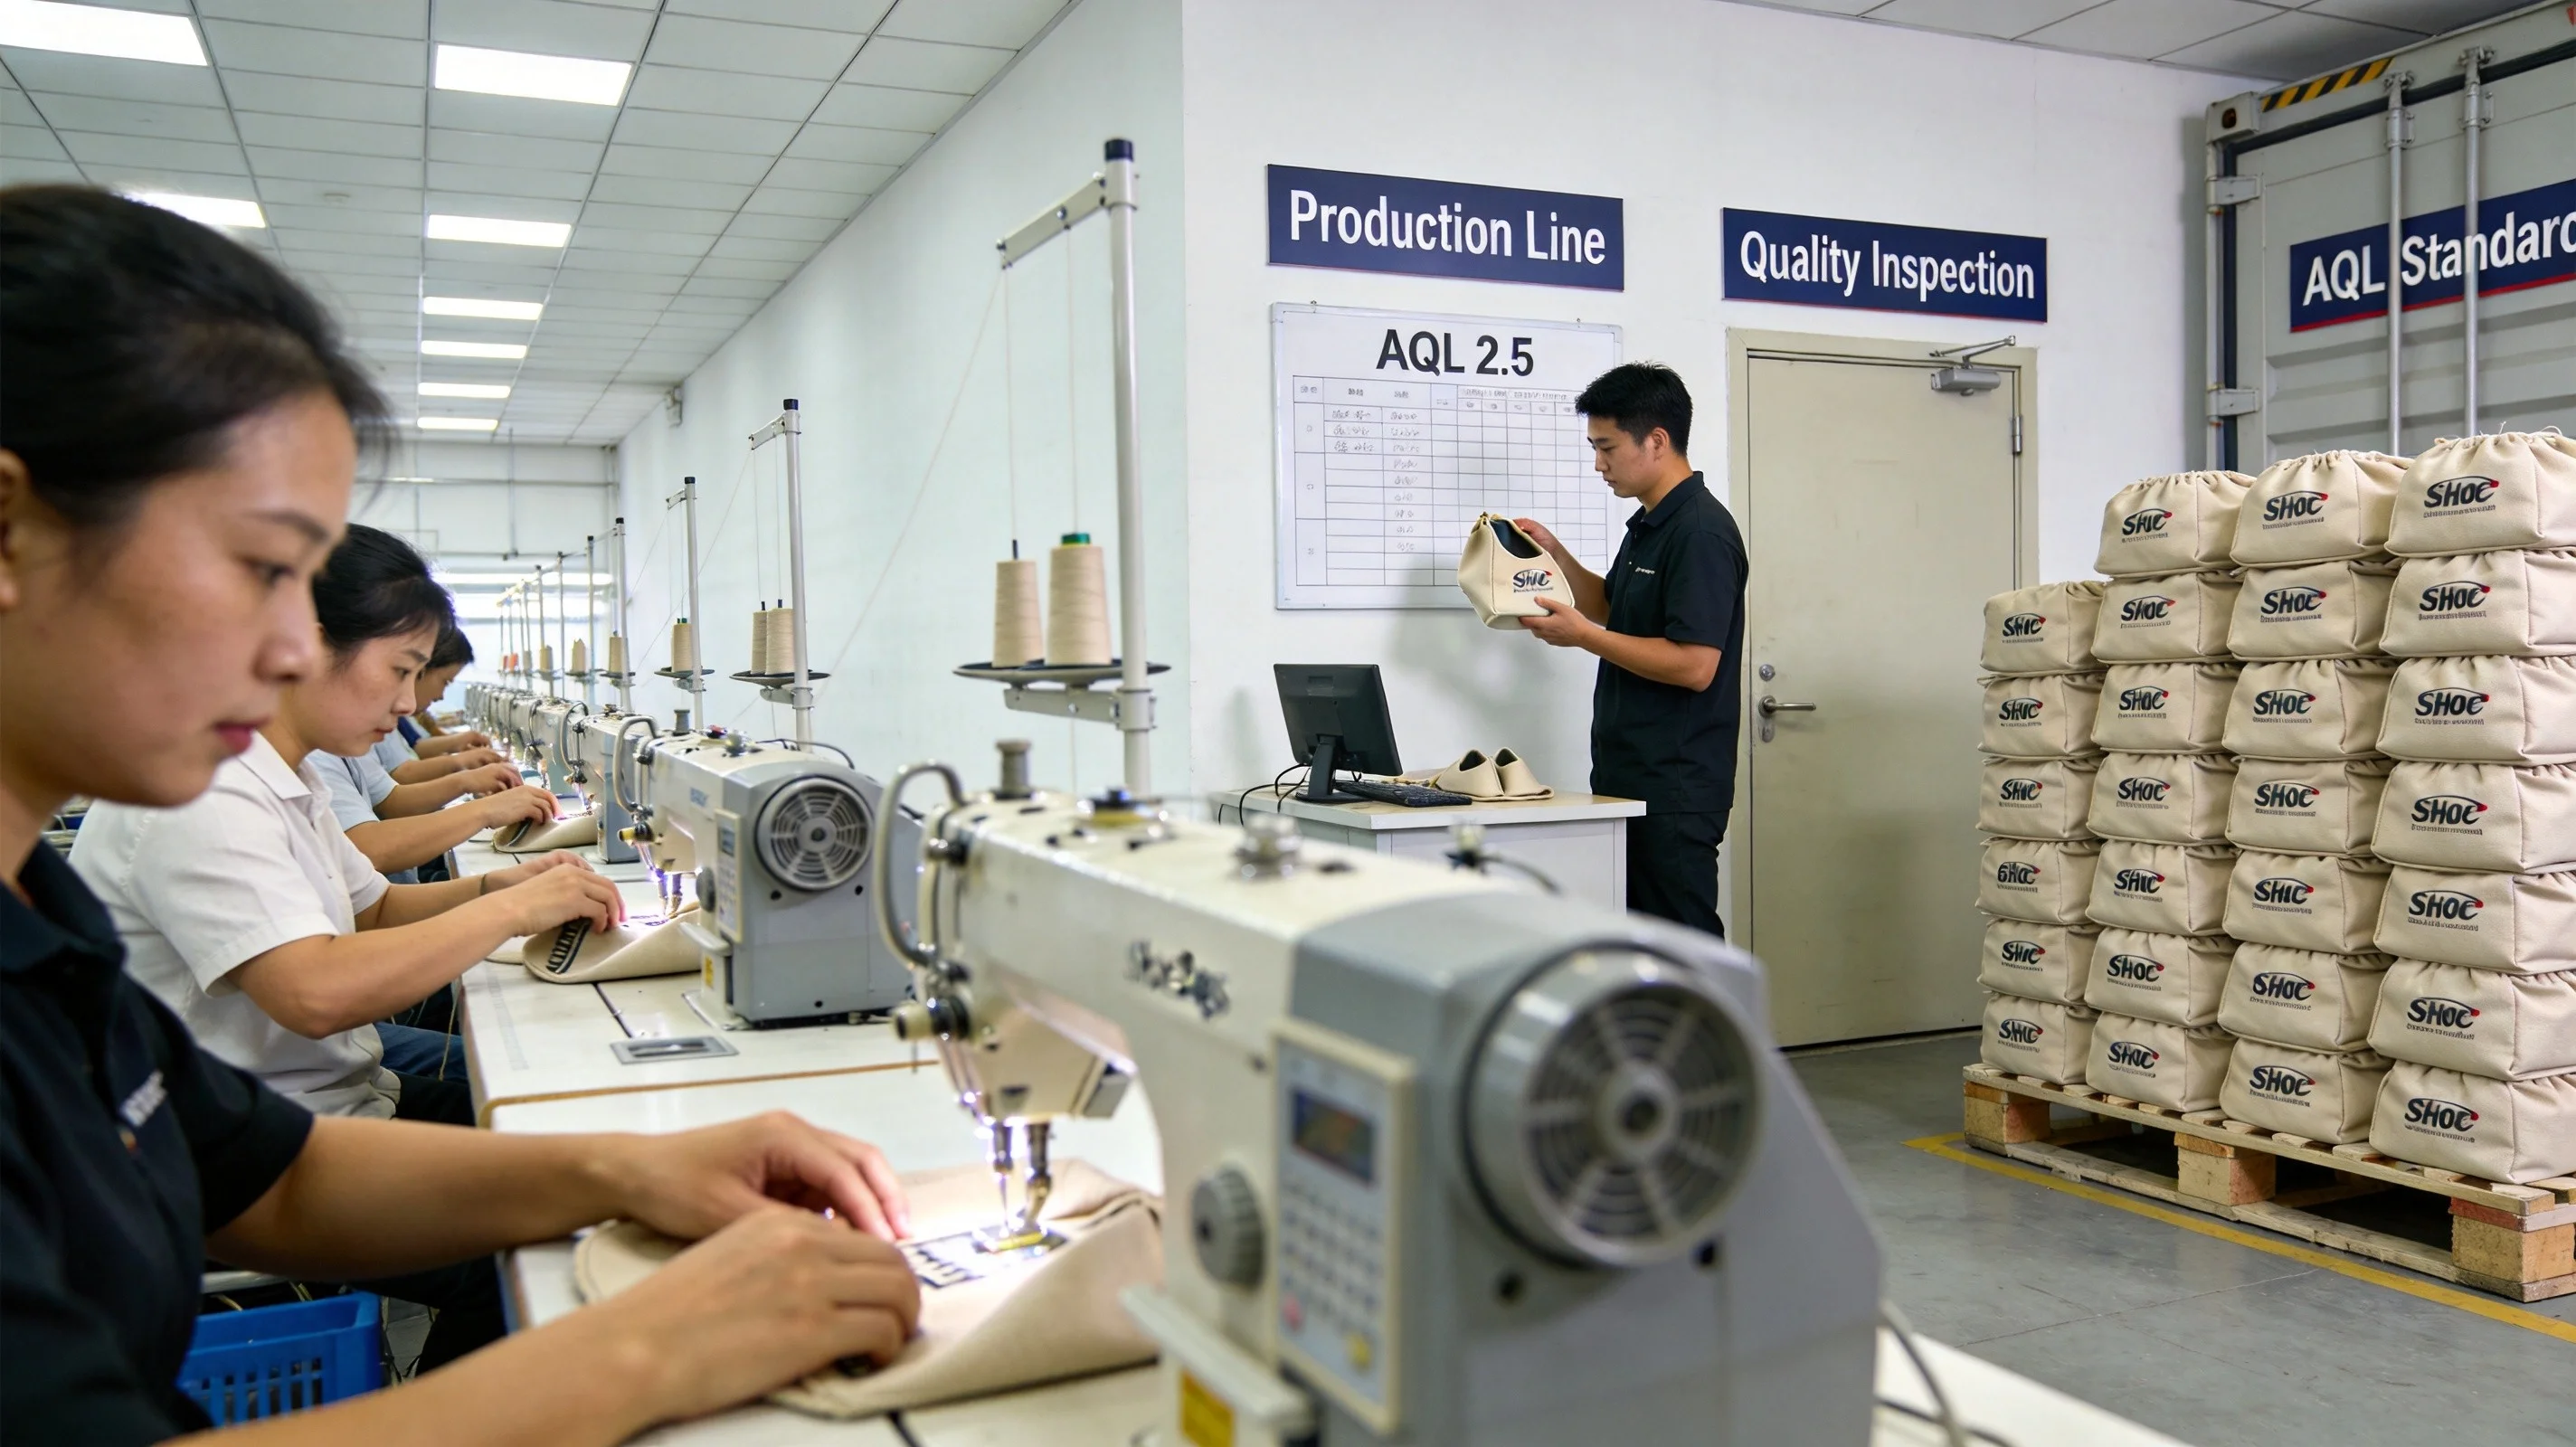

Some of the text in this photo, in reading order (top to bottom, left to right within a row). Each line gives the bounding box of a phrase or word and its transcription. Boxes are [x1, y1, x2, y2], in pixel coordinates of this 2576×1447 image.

[1291, 189, 1605, 265] Production Line
[1740, 231, 2034, 302] Quality Inspection
[2302, 244, 2386, 307] AQL
[1376, 329, 1534, 376] AQL 2.5
